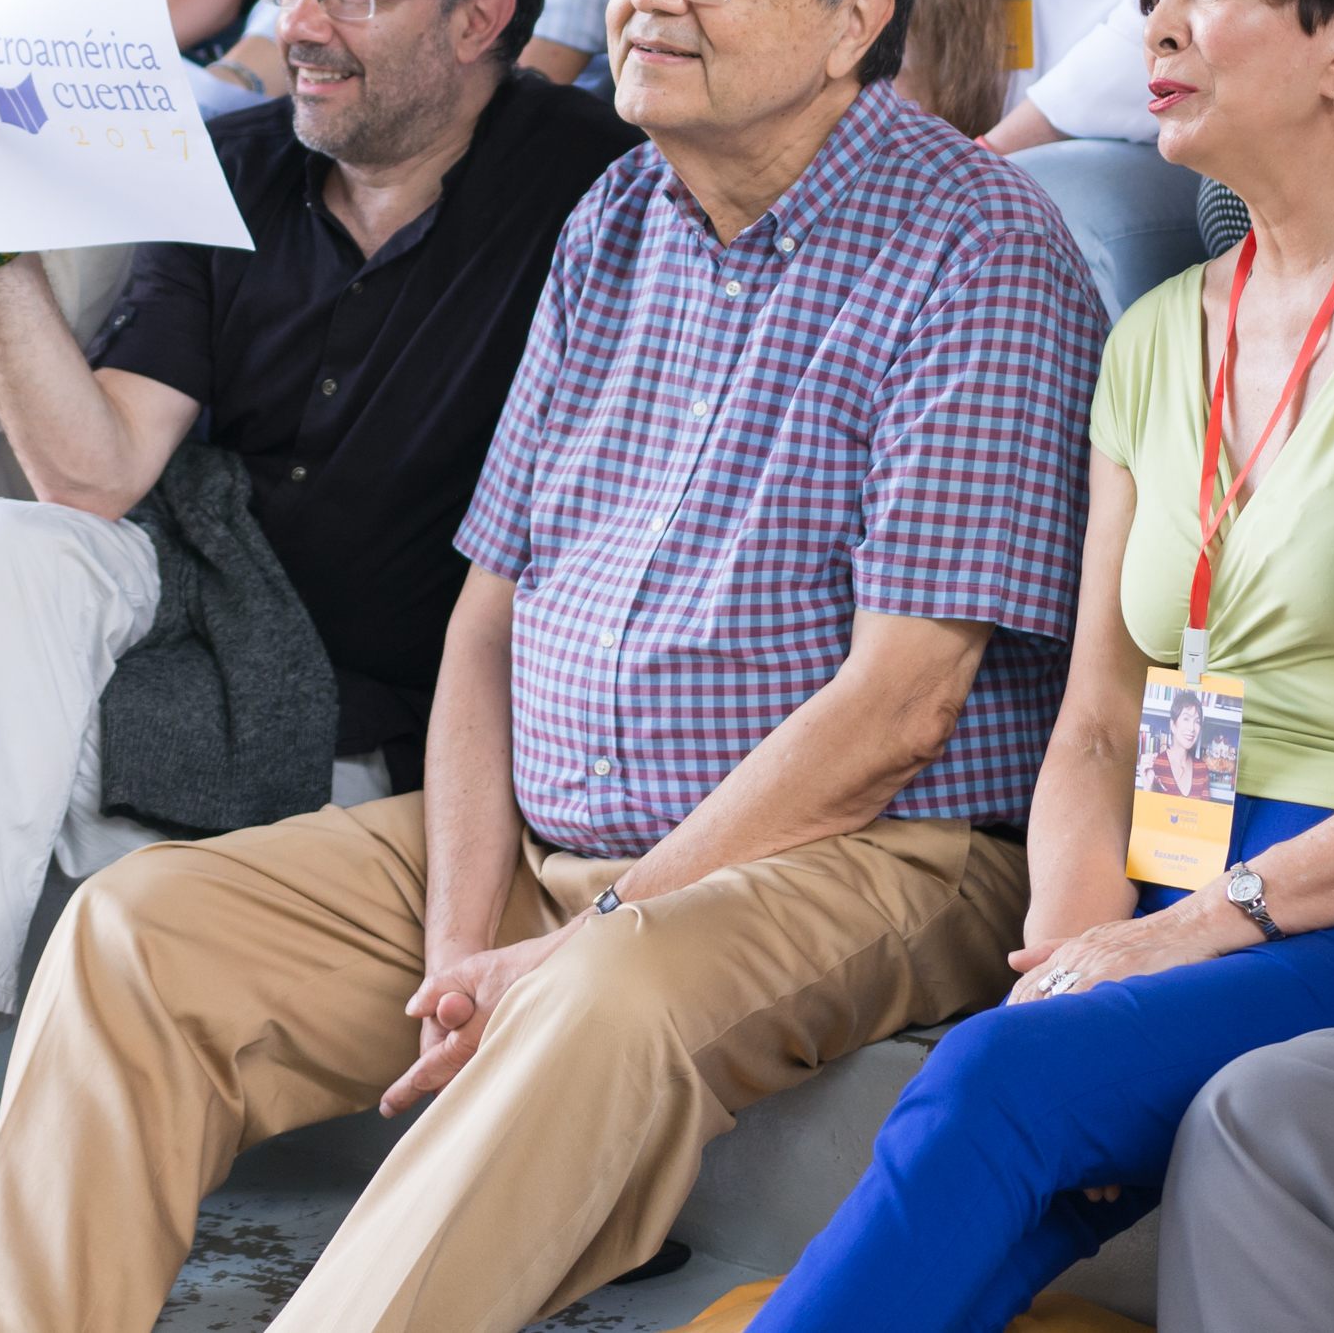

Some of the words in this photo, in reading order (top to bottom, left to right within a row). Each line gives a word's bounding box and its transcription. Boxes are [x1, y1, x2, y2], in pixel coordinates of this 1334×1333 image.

[52, 79, 177, 112] cuenta
[70, 126, 189, 161] 2017
[1154, 849, 1179, 861] Roxana
[1180, 854, 1198, 865] Pinto
